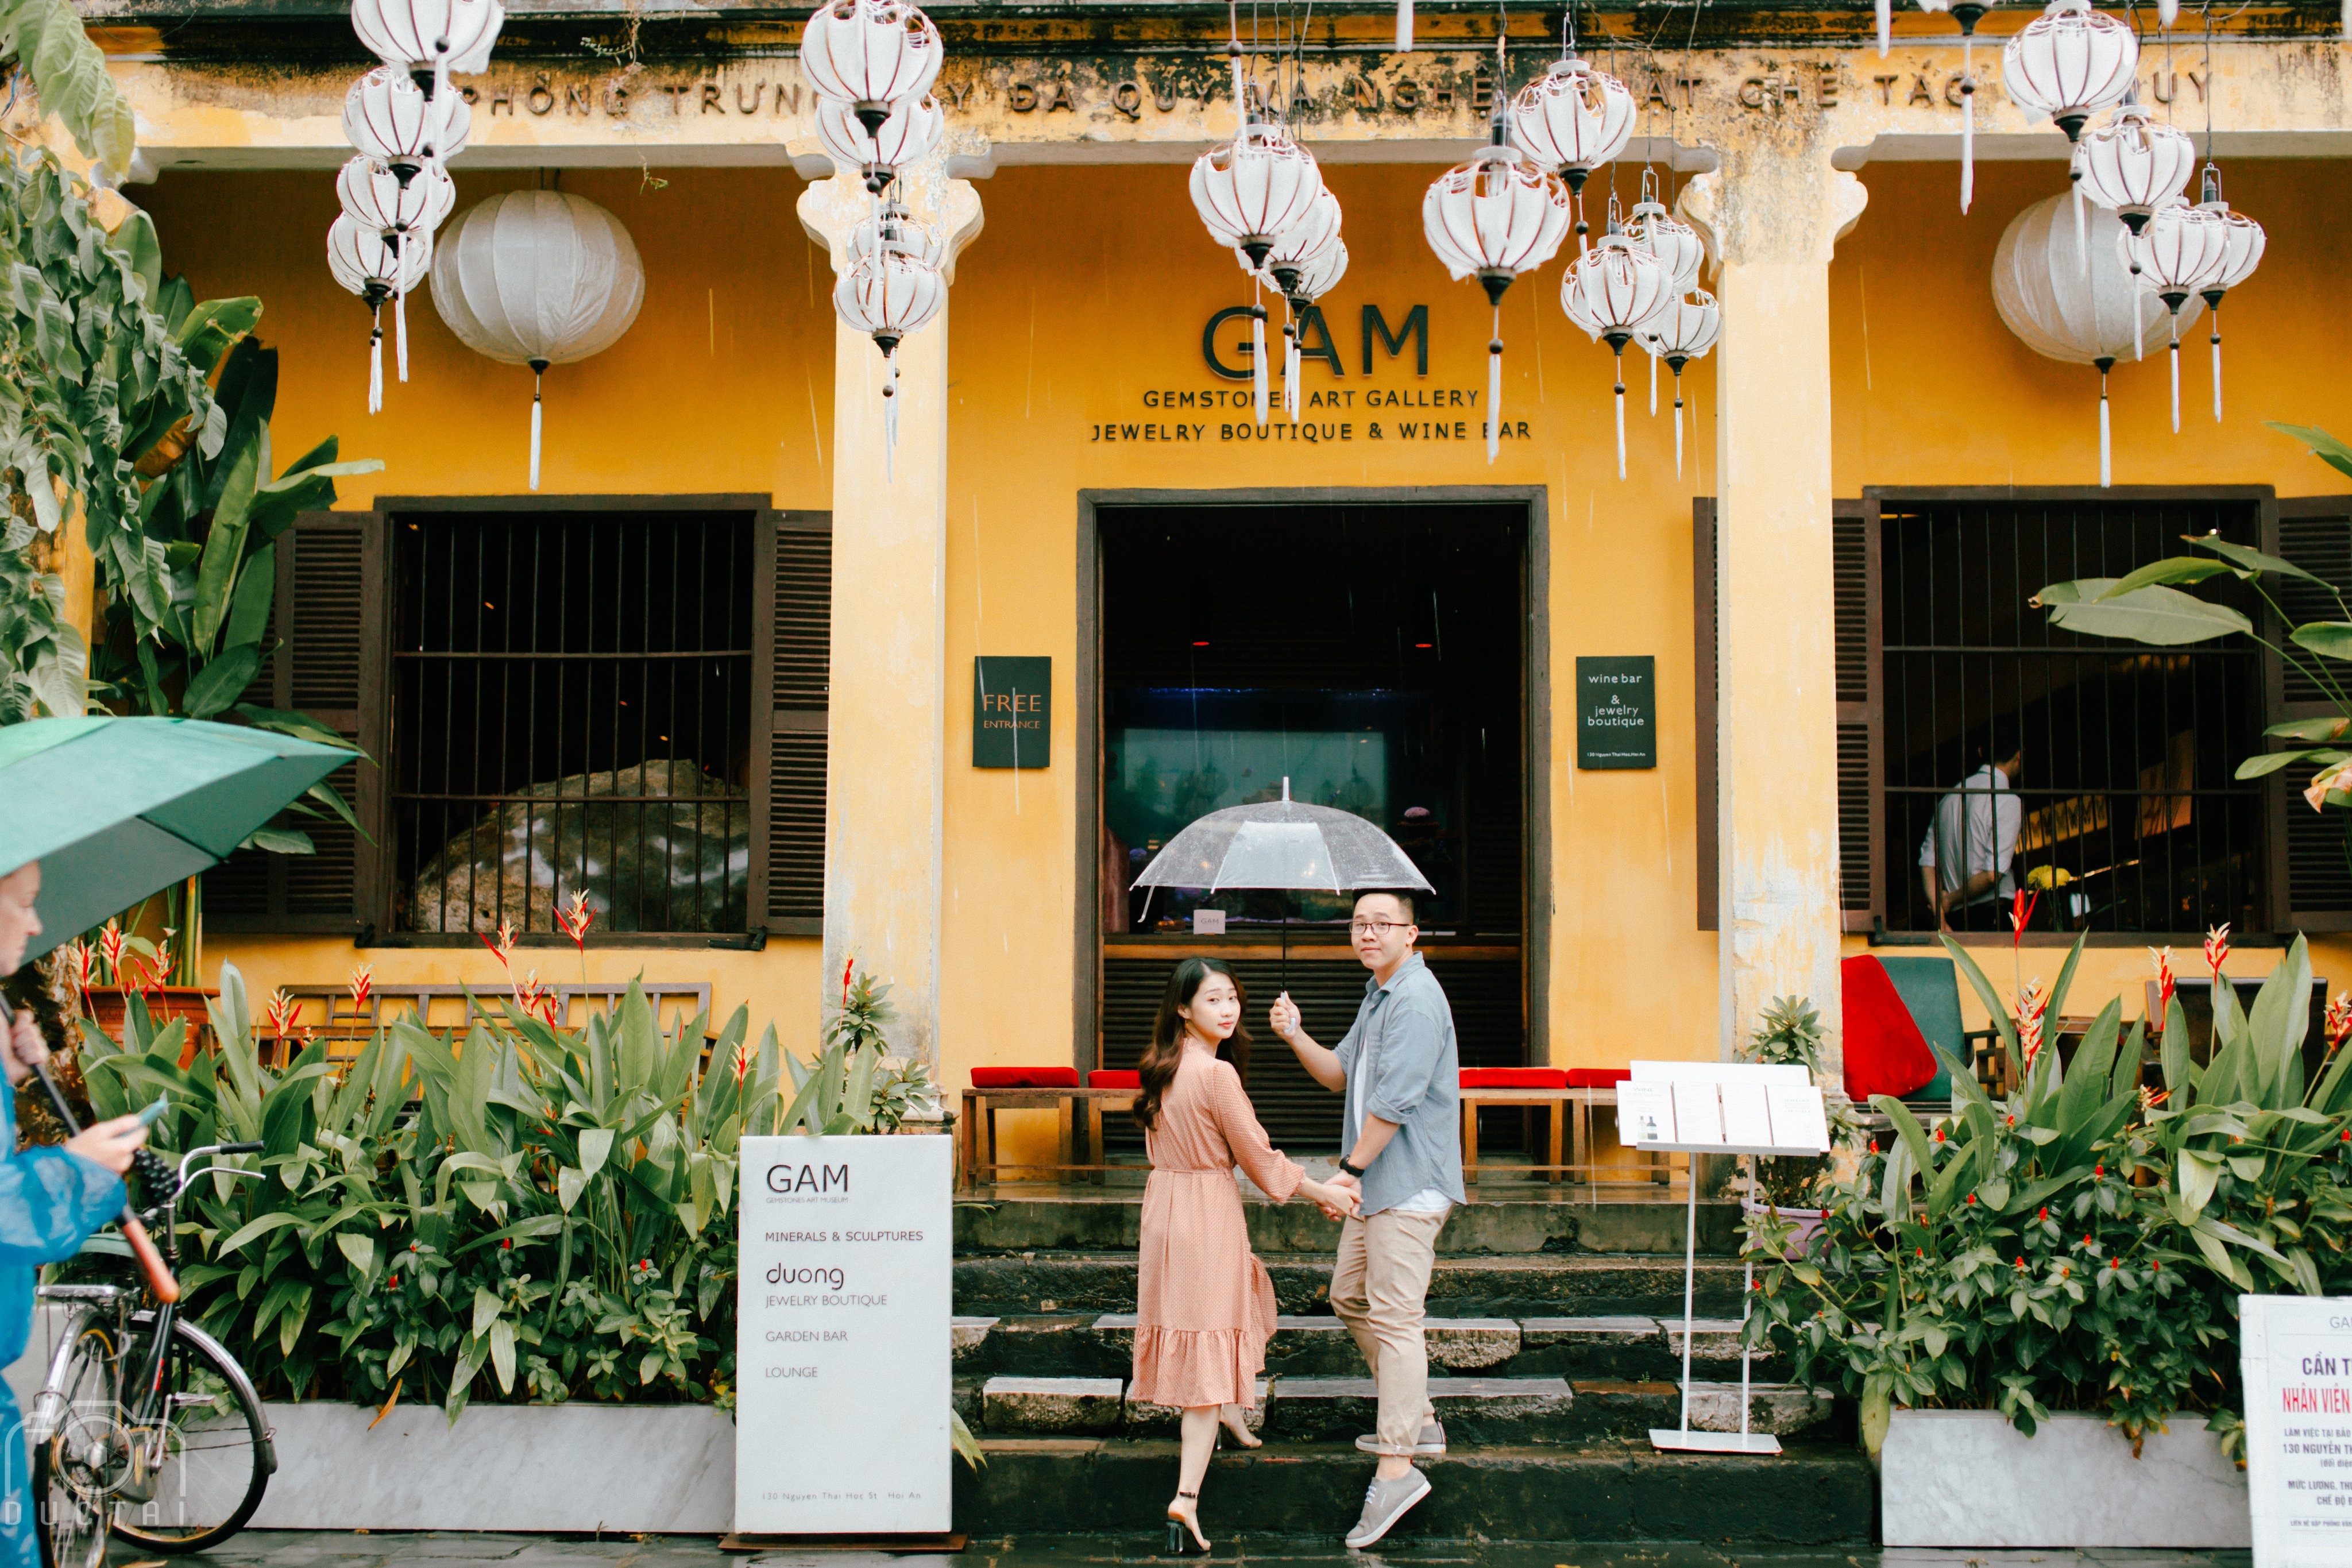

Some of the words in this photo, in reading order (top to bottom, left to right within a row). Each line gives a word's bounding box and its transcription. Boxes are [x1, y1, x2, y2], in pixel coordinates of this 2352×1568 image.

[663, 78, 819, 114] TRƯN
[1203, 305, 1428, 380] GAM
[1144, 391, 1292, 407] GEMSTOE
[1310, 391, 1355, 407] ART
[1366, 390, 1478, 407] GALLERY
[1092, 423, 1205, 440] JEWELRY
[1221, 423, 1352, 442] BOUTIQUE
[1369, 423, 1382, 438] &
[1400, 422, 1466, 438] WINE
[1589, 674, 1618, 683] wine
[1621, 674, 1642, 683] bar
[983, 694, 1041, 712] FREE
[1611, 694, 1620, 704] &
[1595, 705, 1639, 717] jewelry
[984, 720, 1040, 728] ENTRANCE
[1588, 716, 1644, 728] boutique
[767, 1164, 848, 1193] GAM
[766, 1231, 827, 1242] MINERALS
[832, 1231, 841, 1241] &
[846, 1231, 924, 1241] SCULPTURES
[767, 1262, 844, 1290] duong
[766, 1295, 818, 1308] JEWELRY
[822, 1295, 887, 1307] BOUTIQUE
[2330, 1316, 2352, 1328] GA
[766, 1331, 819, 1342] GARDEN
[824, 1331, 848, 1341] BAR
[2303, 1351, 2336, 1376] CẦN
[766, 1367, 818, 1377] LOUNGE
[2283, 1382, 2318, 1413] NHÂN
[2322, 1382, 2351, 1413] VIÊN
[2284, 1444, 2300, 1454] 130
[783, 1493, 817, 1501] Nguyen
